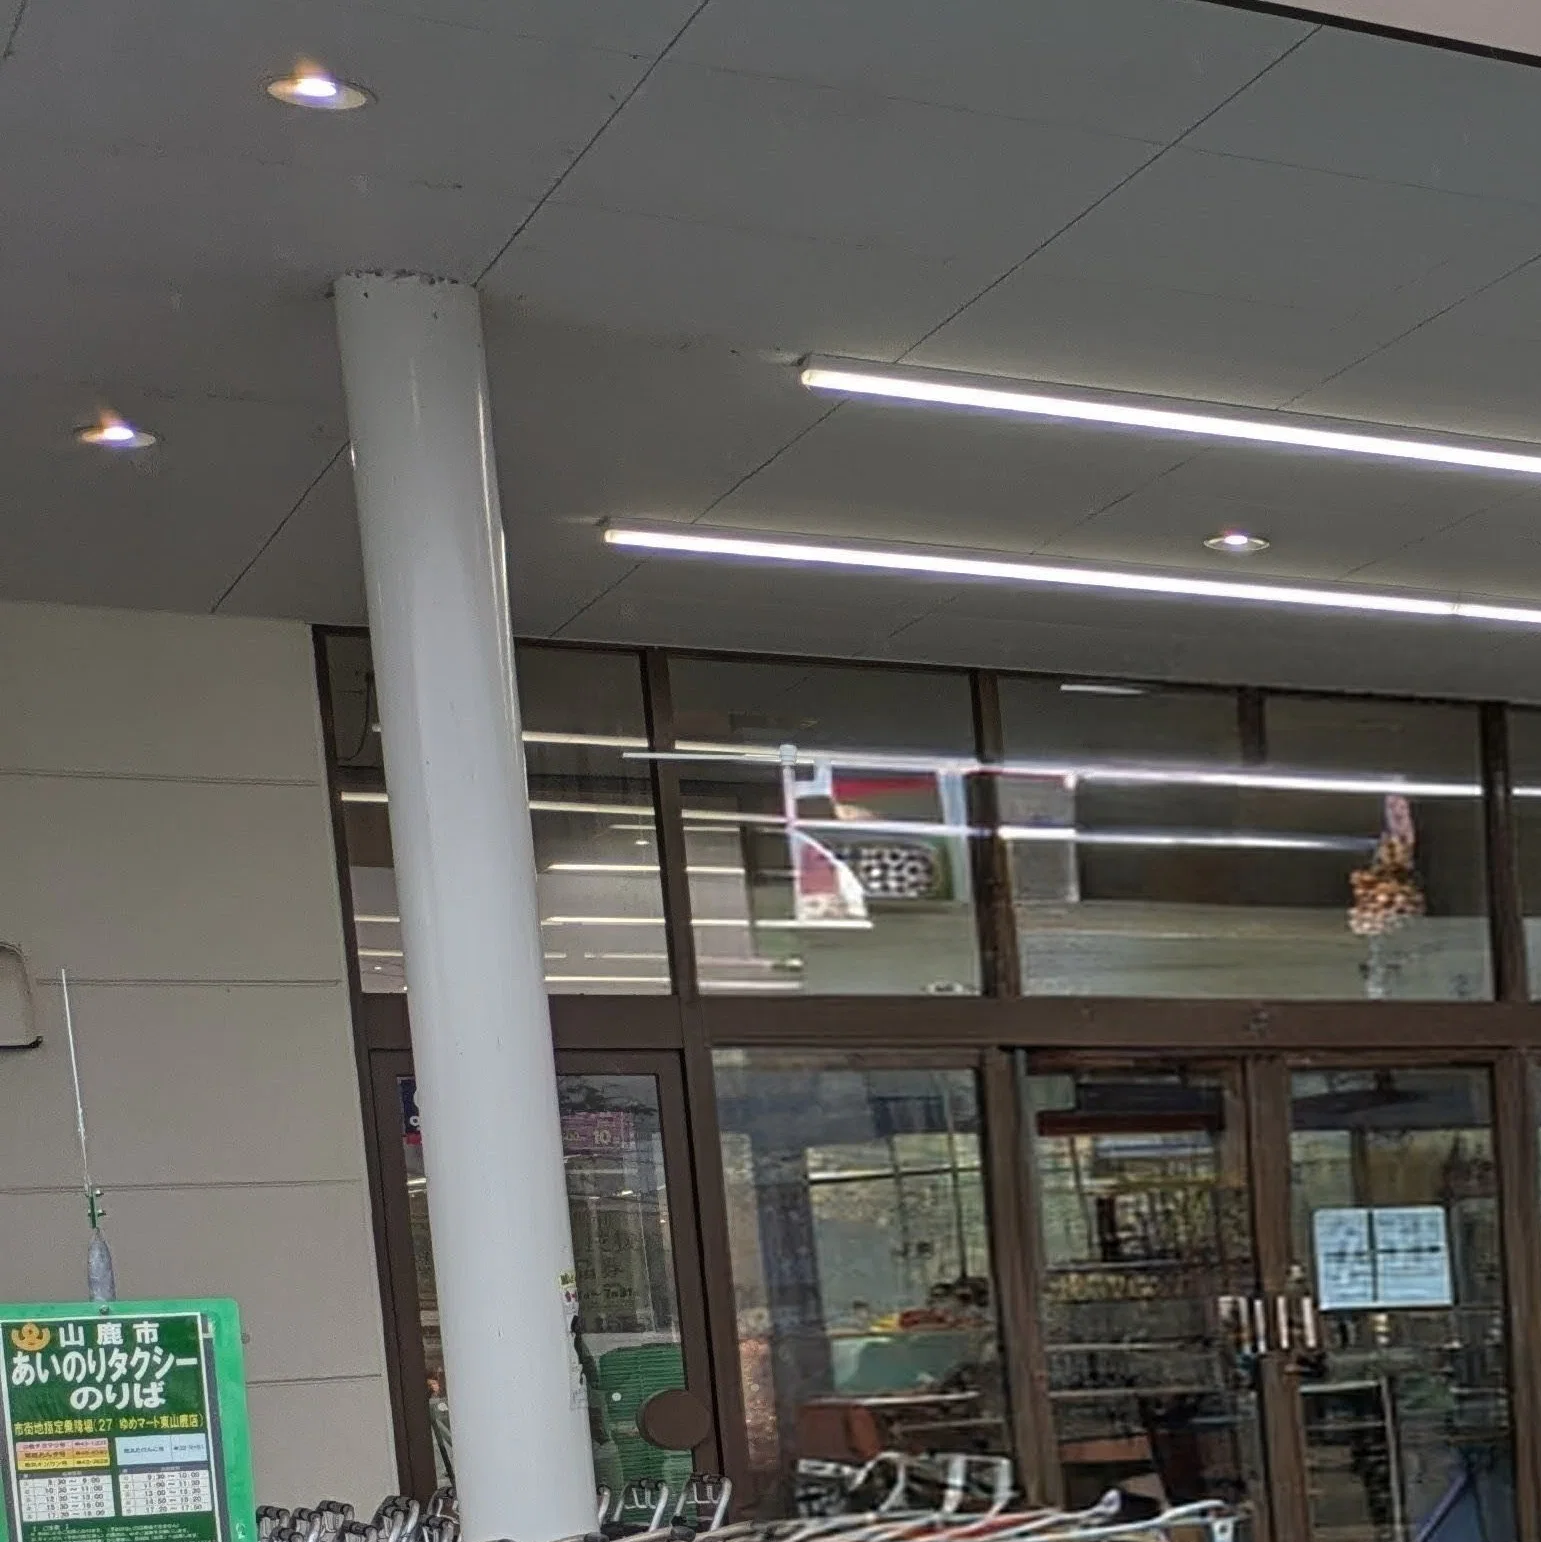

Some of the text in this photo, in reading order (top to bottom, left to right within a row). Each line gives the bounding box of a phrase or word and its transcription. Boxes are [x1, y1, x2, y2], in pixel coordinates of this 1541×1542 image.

[59, 1320, 160, 1348] 山鹿市
[12, 1345, 198, 1386] あいのりタクシー
[70, 1380, 166, 1411] のりば
